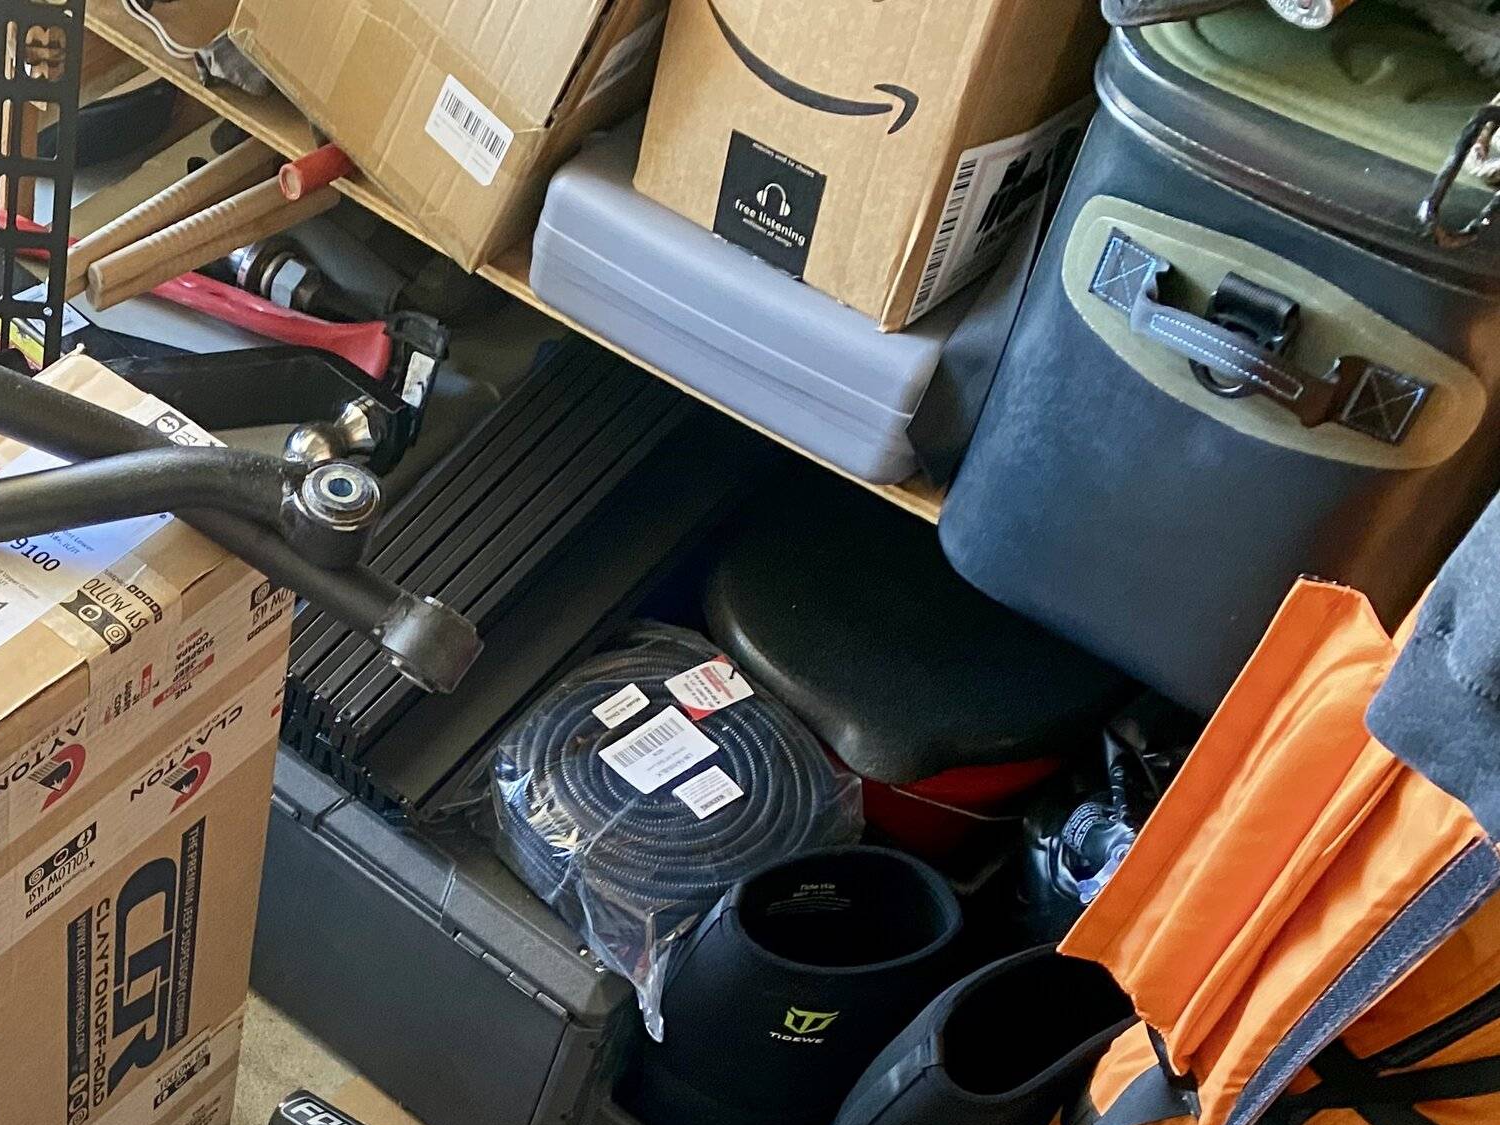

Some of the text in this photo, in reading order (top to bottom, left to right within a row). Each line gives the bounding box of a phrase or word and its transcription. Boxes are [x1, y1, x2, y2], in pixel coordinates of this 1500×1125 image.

[735, 199, 806, 247] free listening
[10, 537, 62, 573] 9100
[82, 578, 127, 613] OLLOW
[130, 704, 243, 803] CLAYTON
[46, 847, 90, 890] FOLLOW
[176, 826, 199, 1038] THE PREMIUM JEEP SUSPENSION COMPANY
[75, 918, 86, 1055] WWW.CLAYTONOFFROAD.COM
[769, 1031, 825, 1044] TIDEWE
